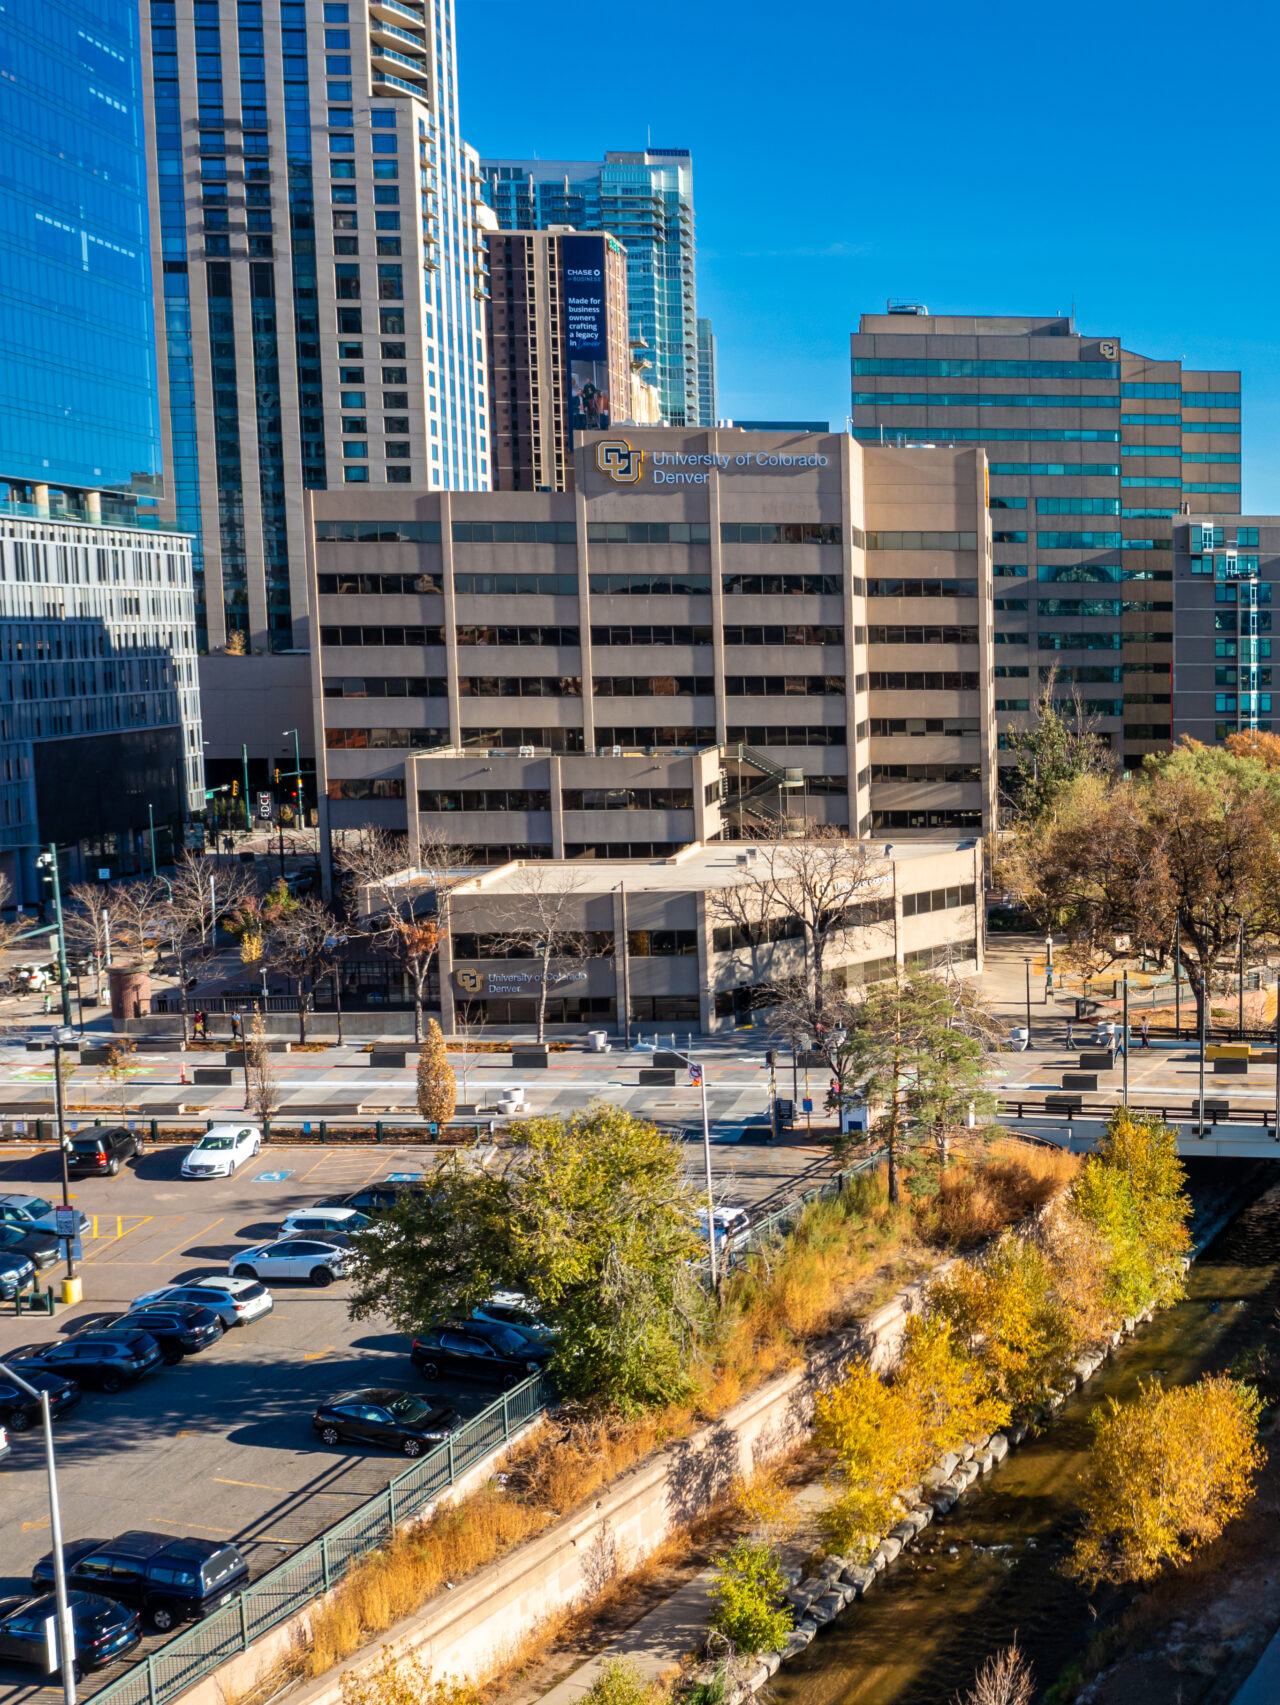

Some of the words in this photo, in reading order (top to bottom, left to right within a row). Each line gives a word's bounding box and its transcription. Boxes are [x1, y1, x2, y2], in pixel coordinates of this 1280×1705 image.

[568, 297, 589, 305] Made
[590, 297, 601, 305] for
[568, 323, 598, 331] crafting
[575, 330, 599, 340] legacy
[652, 451, 731, 470] University
[735, 451, 750, 467] of
[755, 451, 829, 467] Colorado
[653, 469, 710, 485] Denver
[488, 973, 532, 983] University
[546, 972, 587, 981] Colado
[488, 984, 521, 993] Denver
